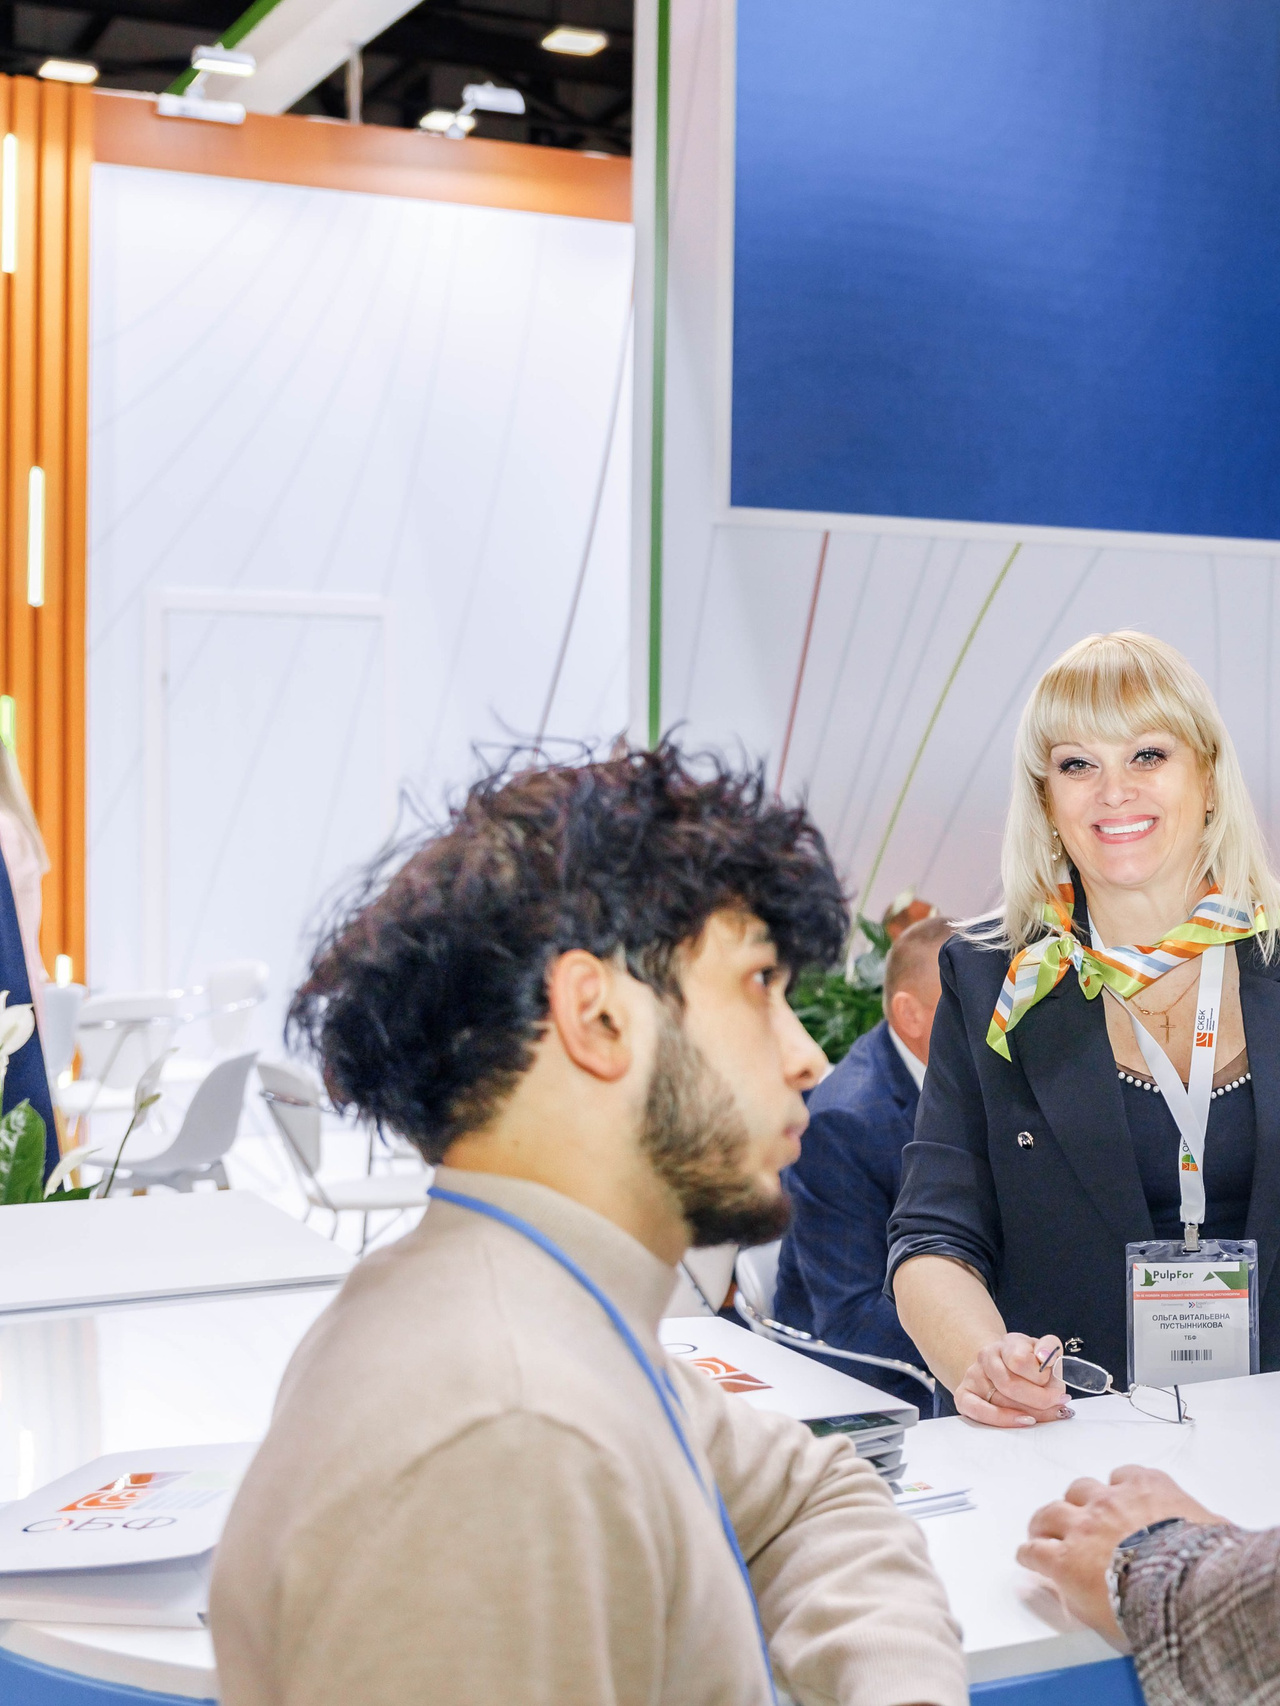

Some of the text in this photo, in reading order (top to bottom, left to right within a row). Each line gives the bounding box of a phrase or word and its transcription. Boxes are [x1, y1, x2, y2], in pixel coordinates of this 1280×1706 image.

[1153, 1270, 1194, 1281] PulpFor
[1180, 1313, 1230, 1321] ВИТАЛЬЕВНА
[22, 1516, 178, 1532] ОБФ
